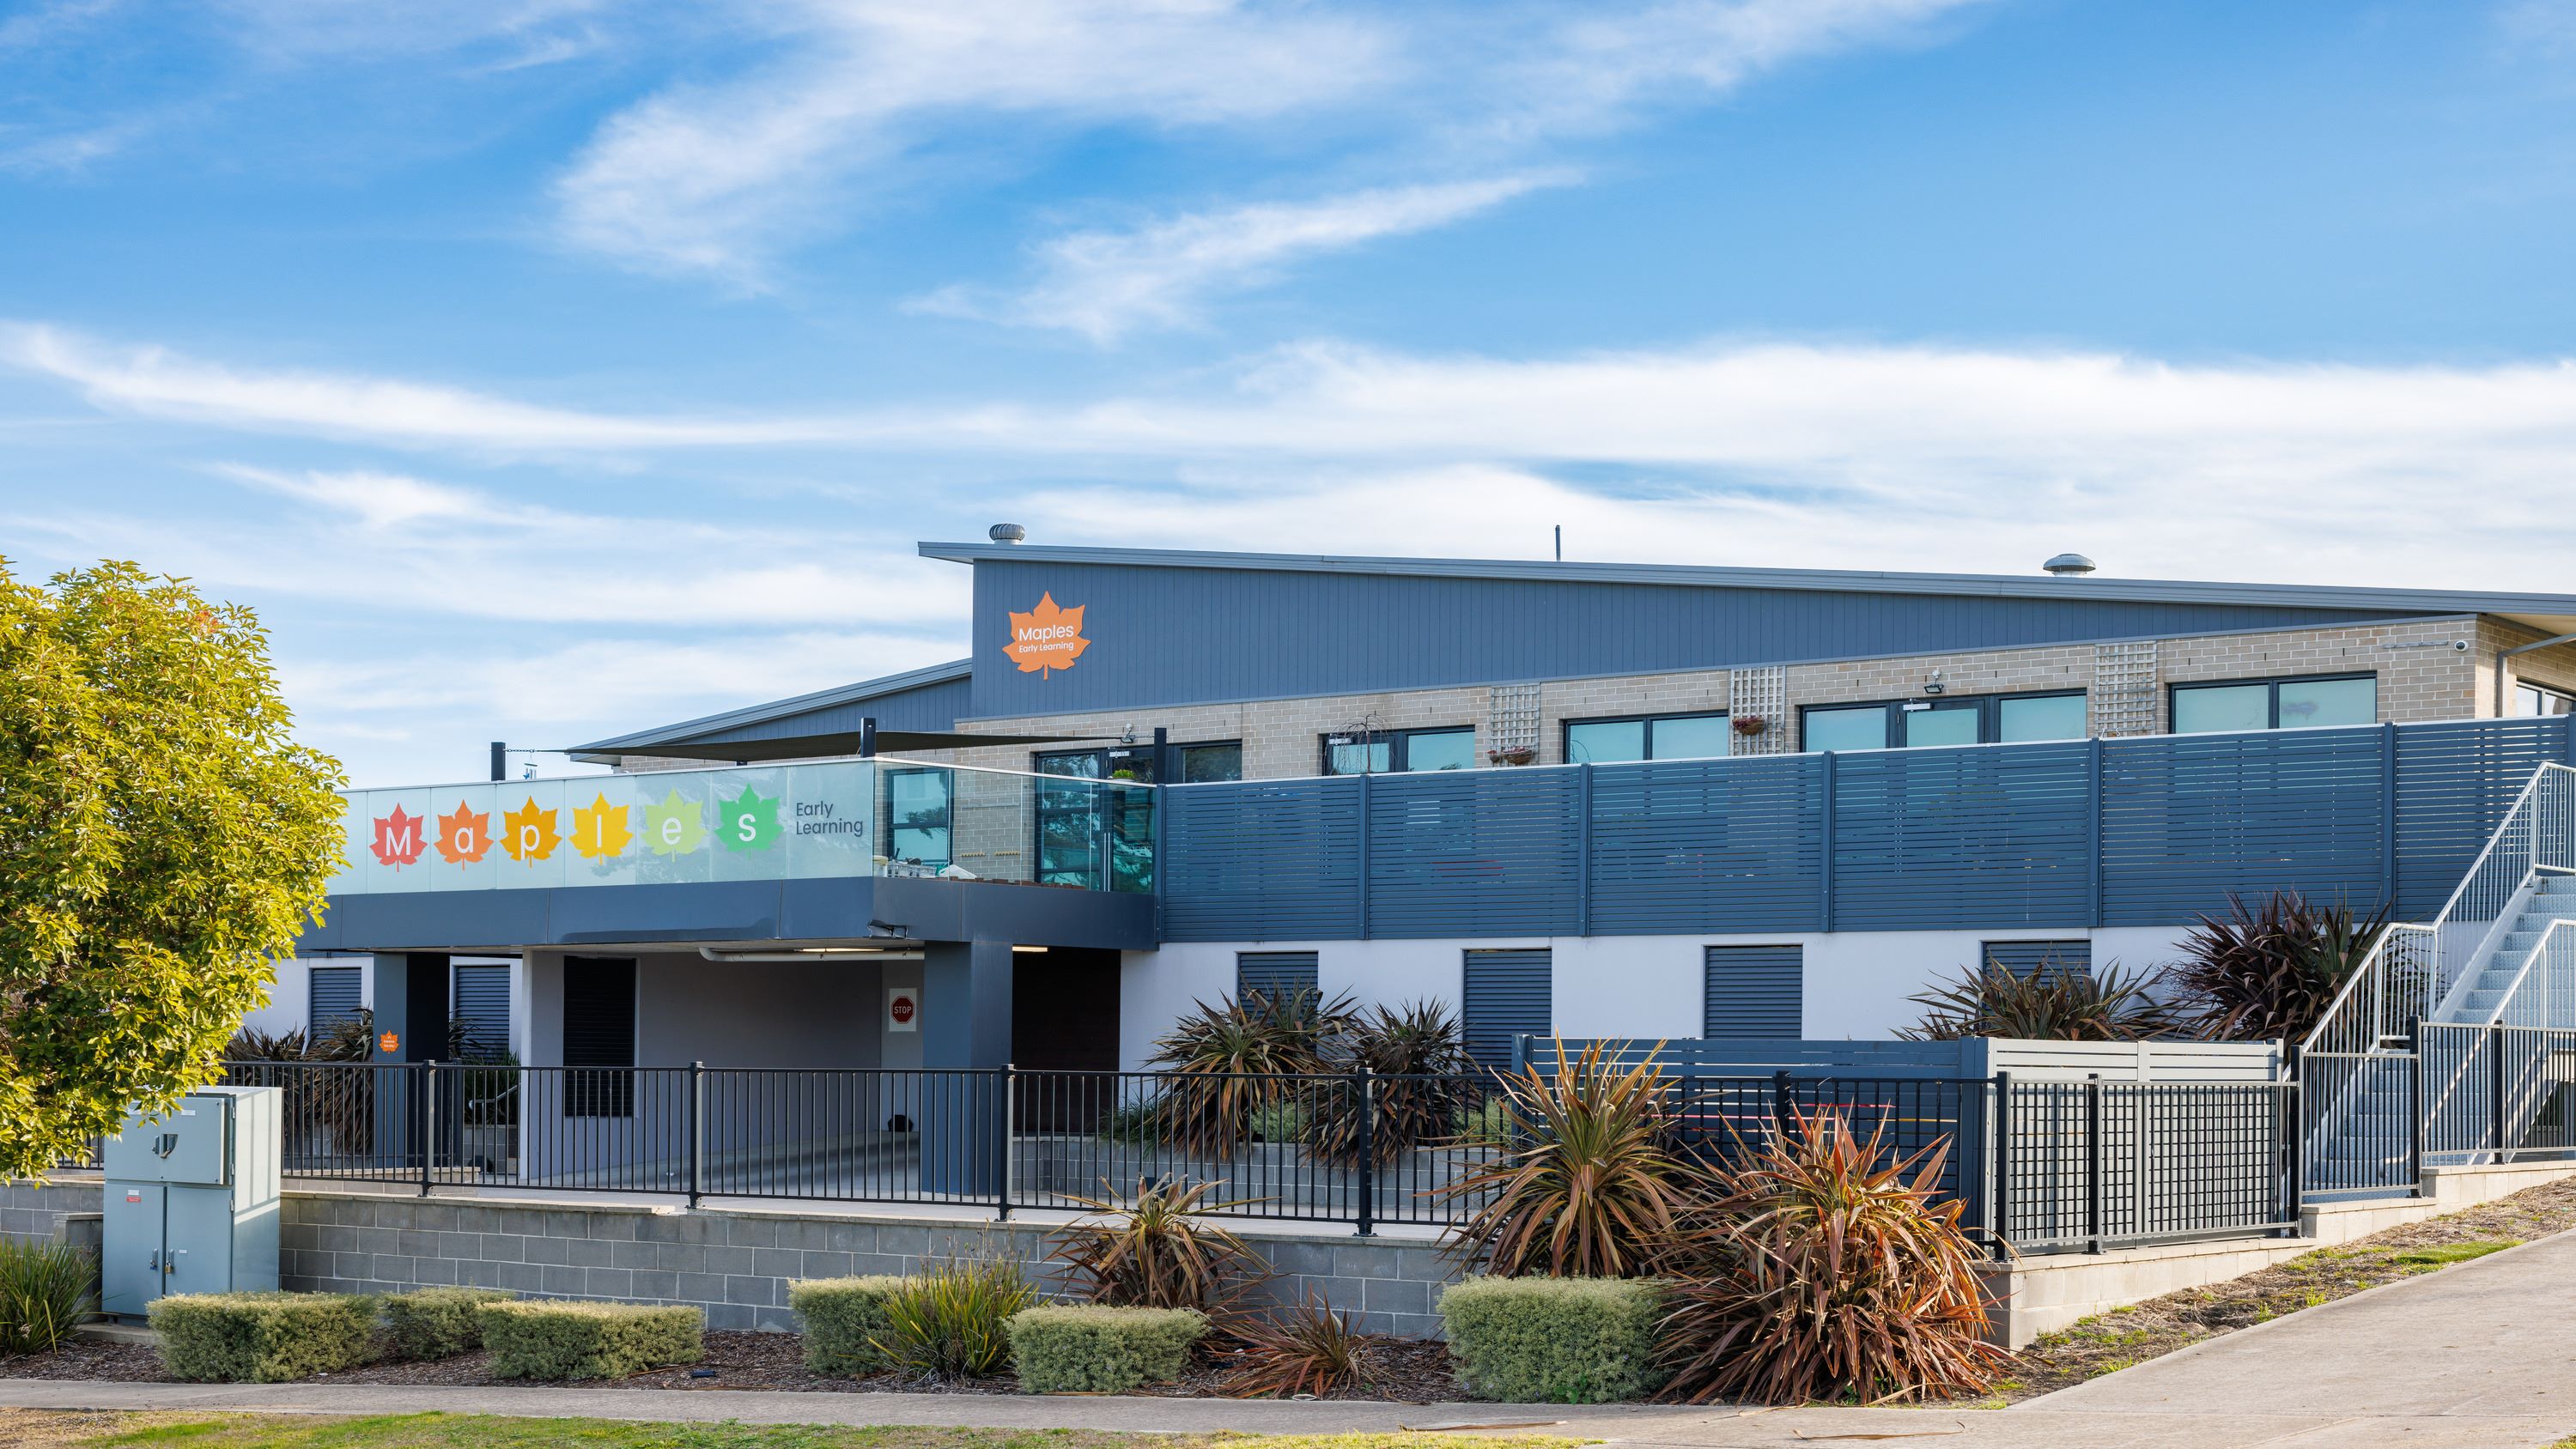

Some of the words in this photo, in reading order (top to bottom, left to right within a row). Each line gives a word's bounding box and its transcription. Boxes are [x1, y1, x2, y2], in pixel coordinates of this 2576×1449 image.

[1018, 624, 1074, 643] Maples
[1018, 644, 1038, 653] Early
[1039, 641, 1074, 651] Learning
[796, 800, 834, 819] Early
[796, 817, 863, 838] Learning
